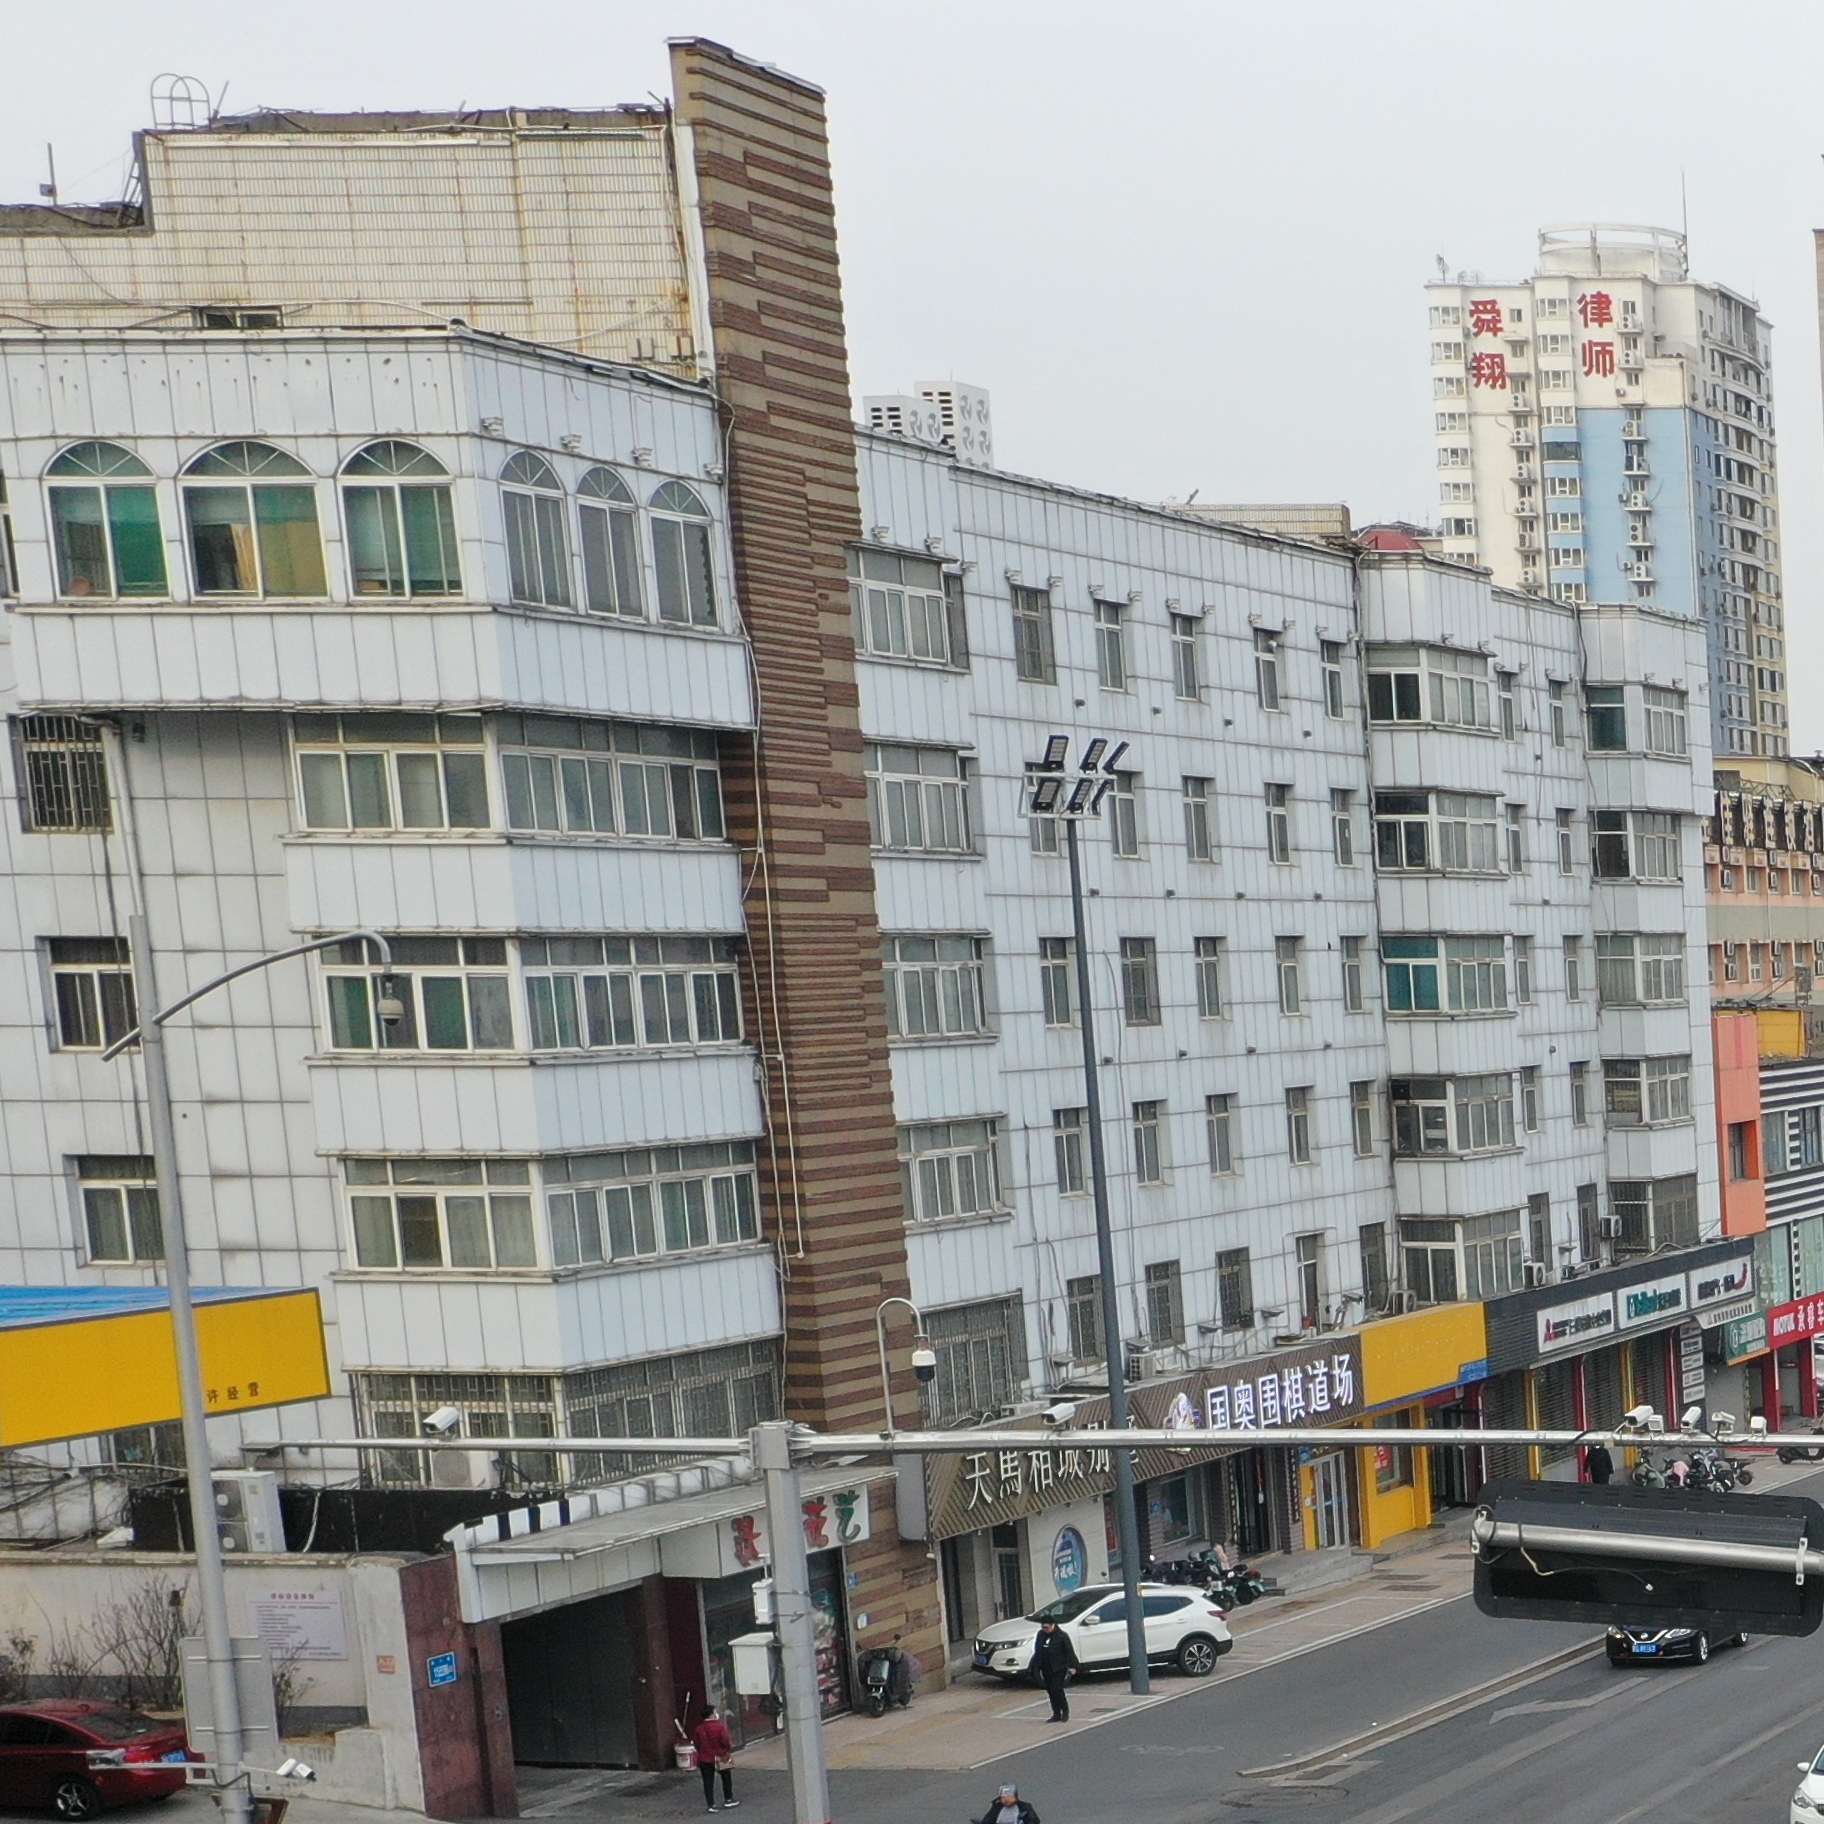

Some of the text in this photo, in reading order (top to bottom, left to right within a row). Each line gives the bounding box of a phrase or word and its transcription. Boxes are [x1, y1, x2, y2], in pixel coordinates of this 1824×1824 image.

[1469, 299, 1507, 390] 舜翔
[1577, 291, 1615, 378] 律师
[1205, 1354, 1354, 1430] 国奥围棋道场
